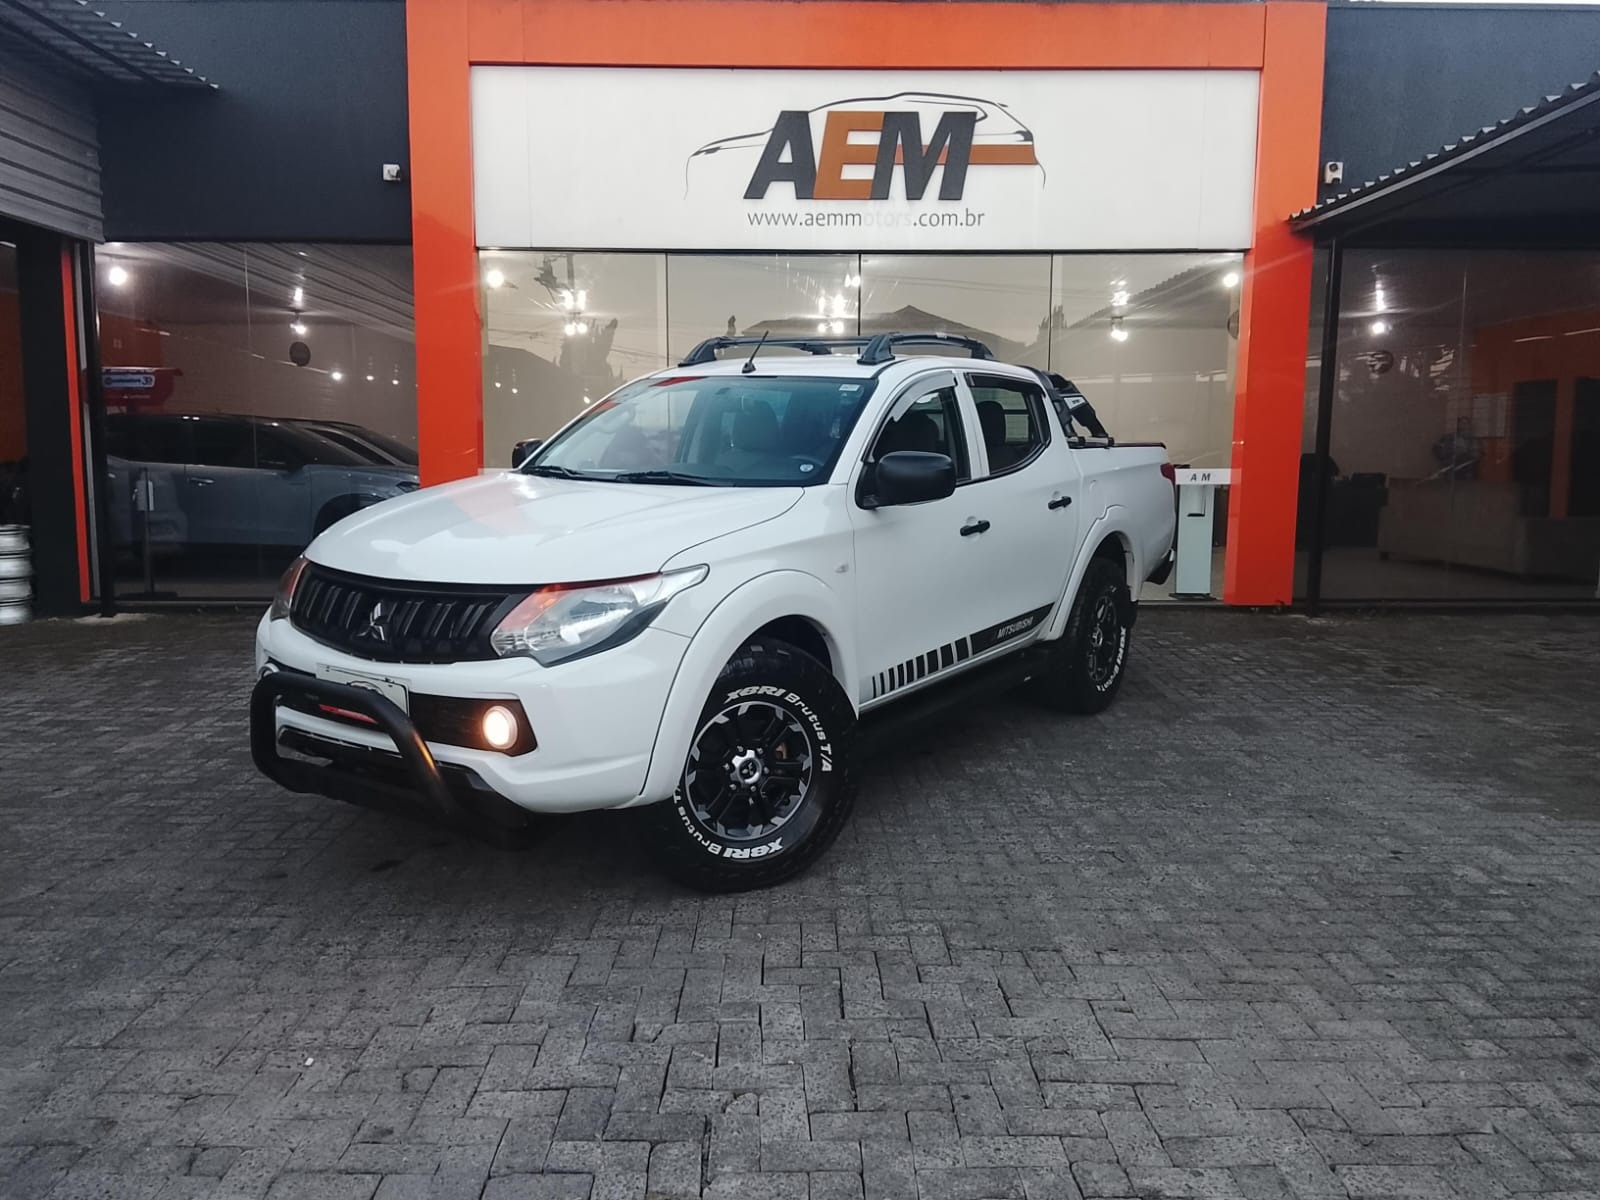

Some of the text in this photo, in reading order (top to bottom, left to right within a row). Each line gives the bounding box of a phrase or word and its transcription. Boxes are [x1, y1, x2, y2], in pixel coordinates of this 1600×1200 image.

[743, 110, 978, 200] AEM
[784, 692, 826, 741] Brutus
[678, 806, 722, 855] Brutus
